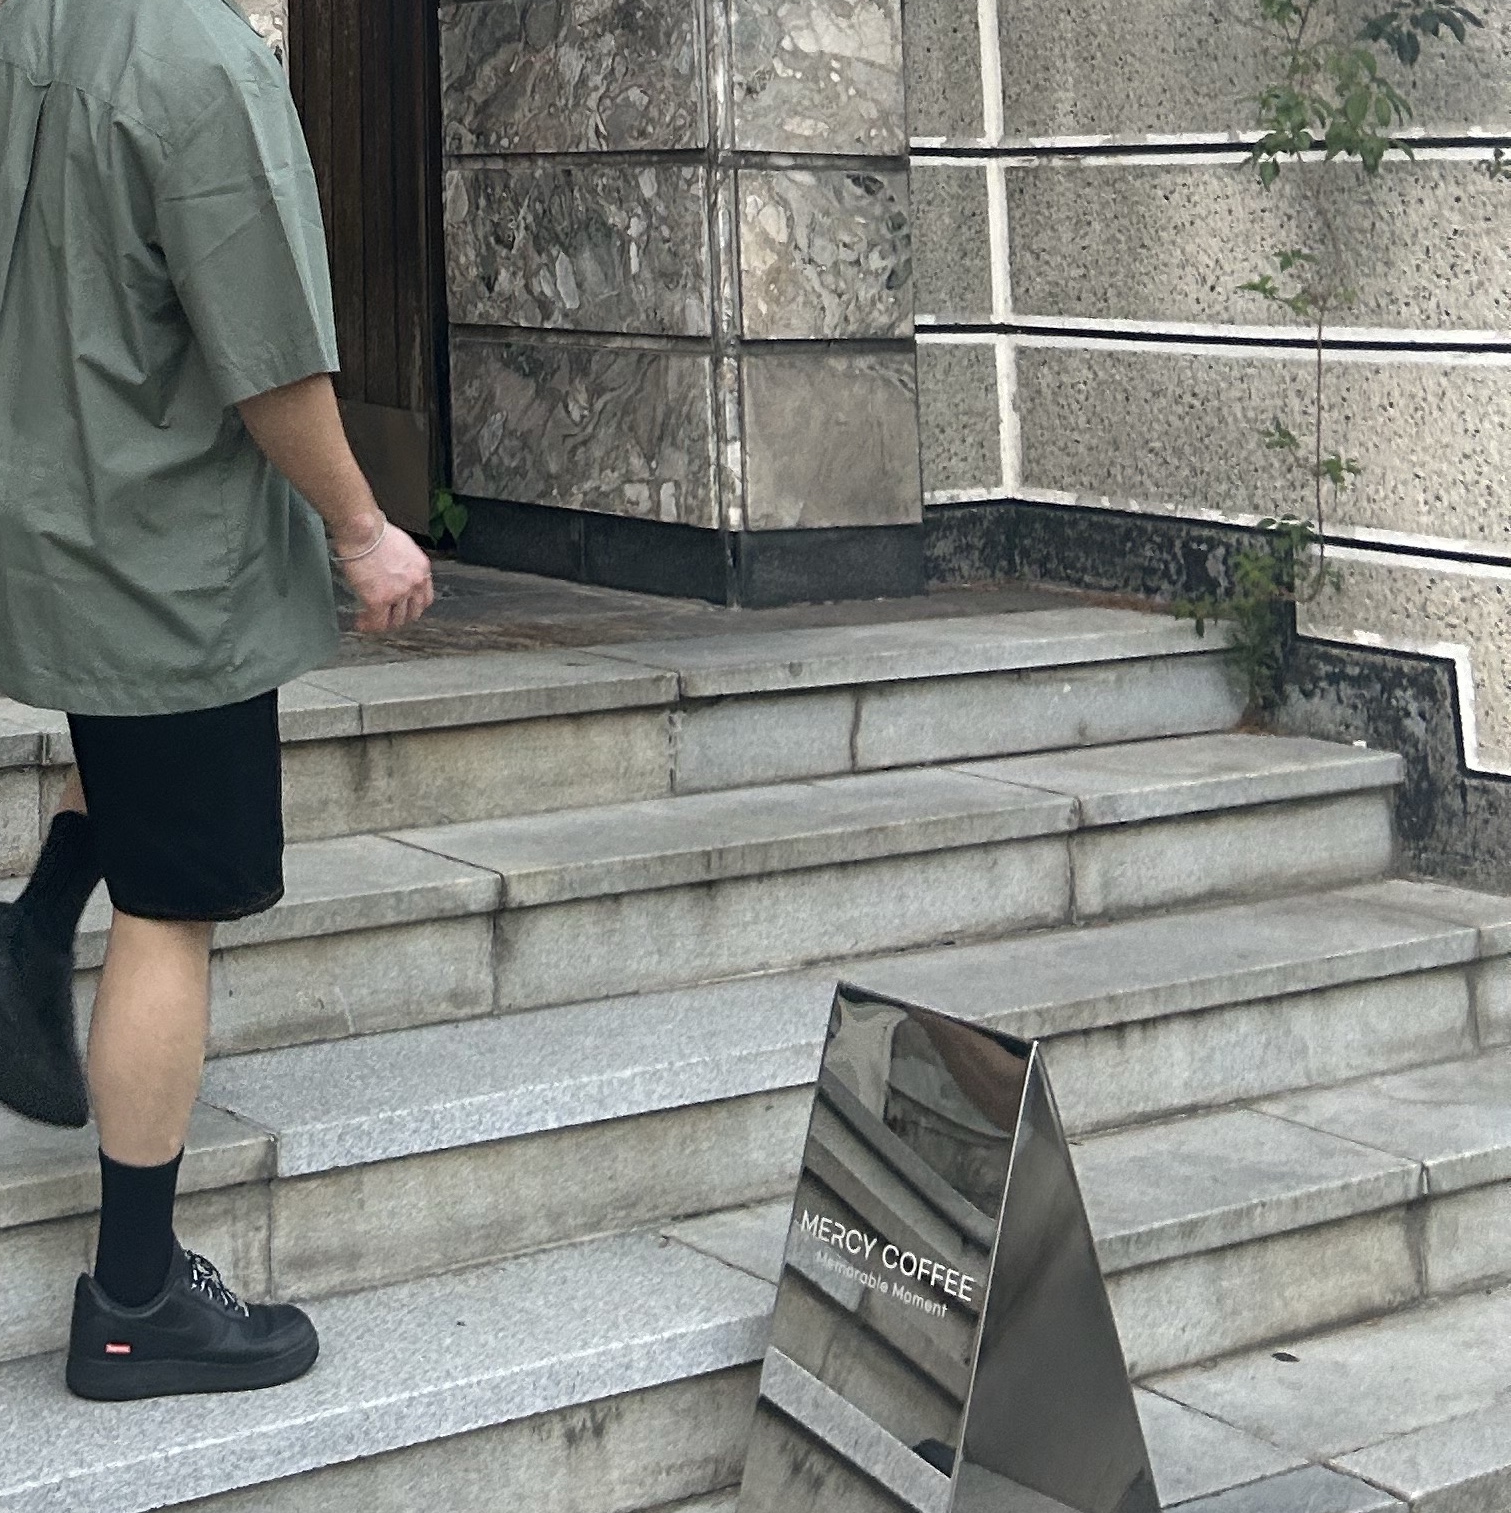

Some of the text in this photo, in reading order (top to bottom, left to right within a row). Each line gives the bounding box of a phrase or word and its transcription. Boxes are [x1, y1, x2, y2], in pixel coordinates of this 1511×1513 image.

[800, 1209, 977, 1302] MERCY COFFEE
[814, 1249, 948, 1319] Memorable Moment
